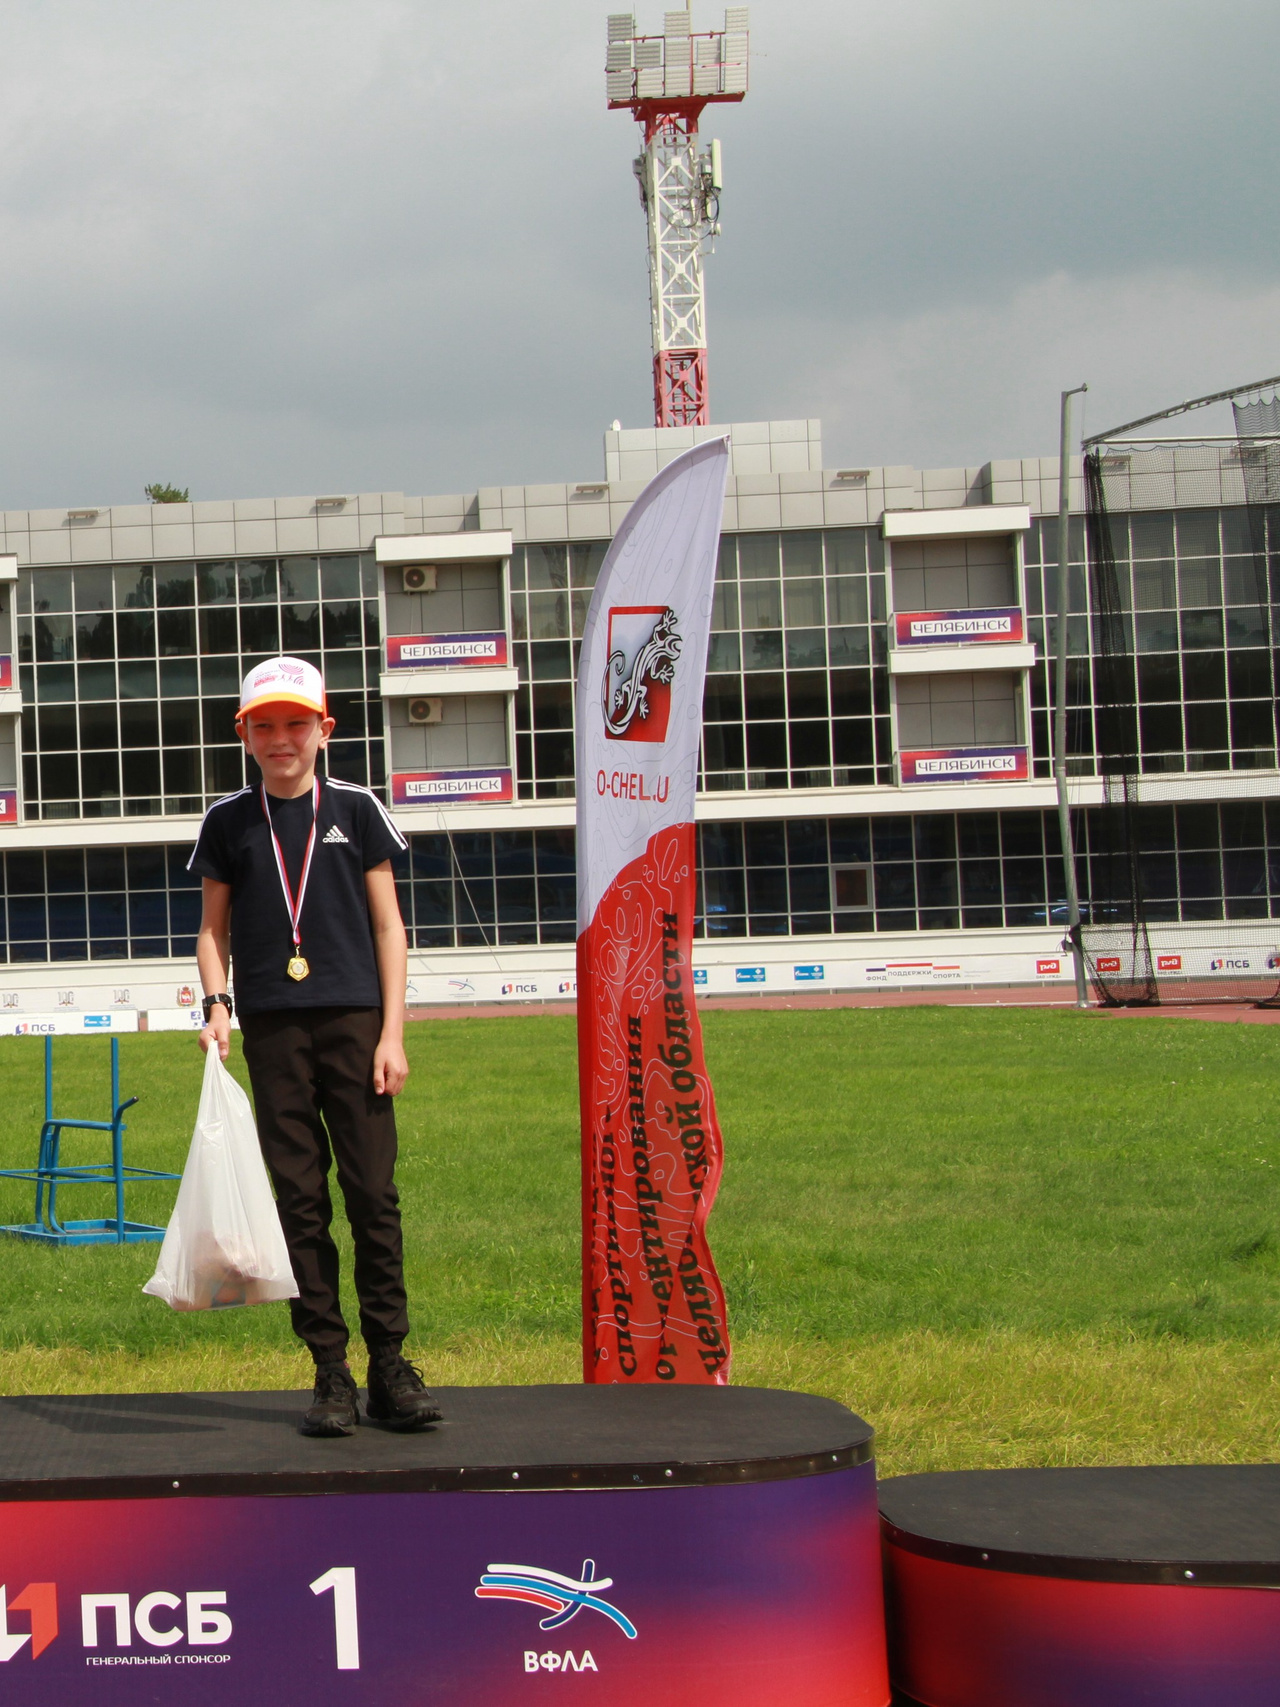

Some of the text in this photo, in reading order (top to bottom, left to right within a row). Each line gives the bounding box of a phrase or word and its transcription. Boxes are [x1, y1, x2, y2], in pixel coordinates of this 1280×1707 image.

[913, 619, 1008, 634] ЧЕЛЯБИНСК
[402, 643, 494, 657] ЧЕЛЯБИНСК
[917, 758, 1014, 773] ЧЕЛЯБИНСК
[408, 779, 500, 794] ЧЕЛЯБИНСК
[1226, 960, 1250, 968] ПСБ
[516, 984, 538, 993] ПСБ
[657, 911, 696, 1094] области
[31, 1024, 56, 1032] ПСБ
[80, 1590, 233, 1647] ПСБ
[309, 1567, 360, 1670] 1
[86, 1654, 231, 1666] ГЕНЕРАЛЬНЫЙ СПОНСОР
[523, 1649, 599, 1673] ВФЛА
